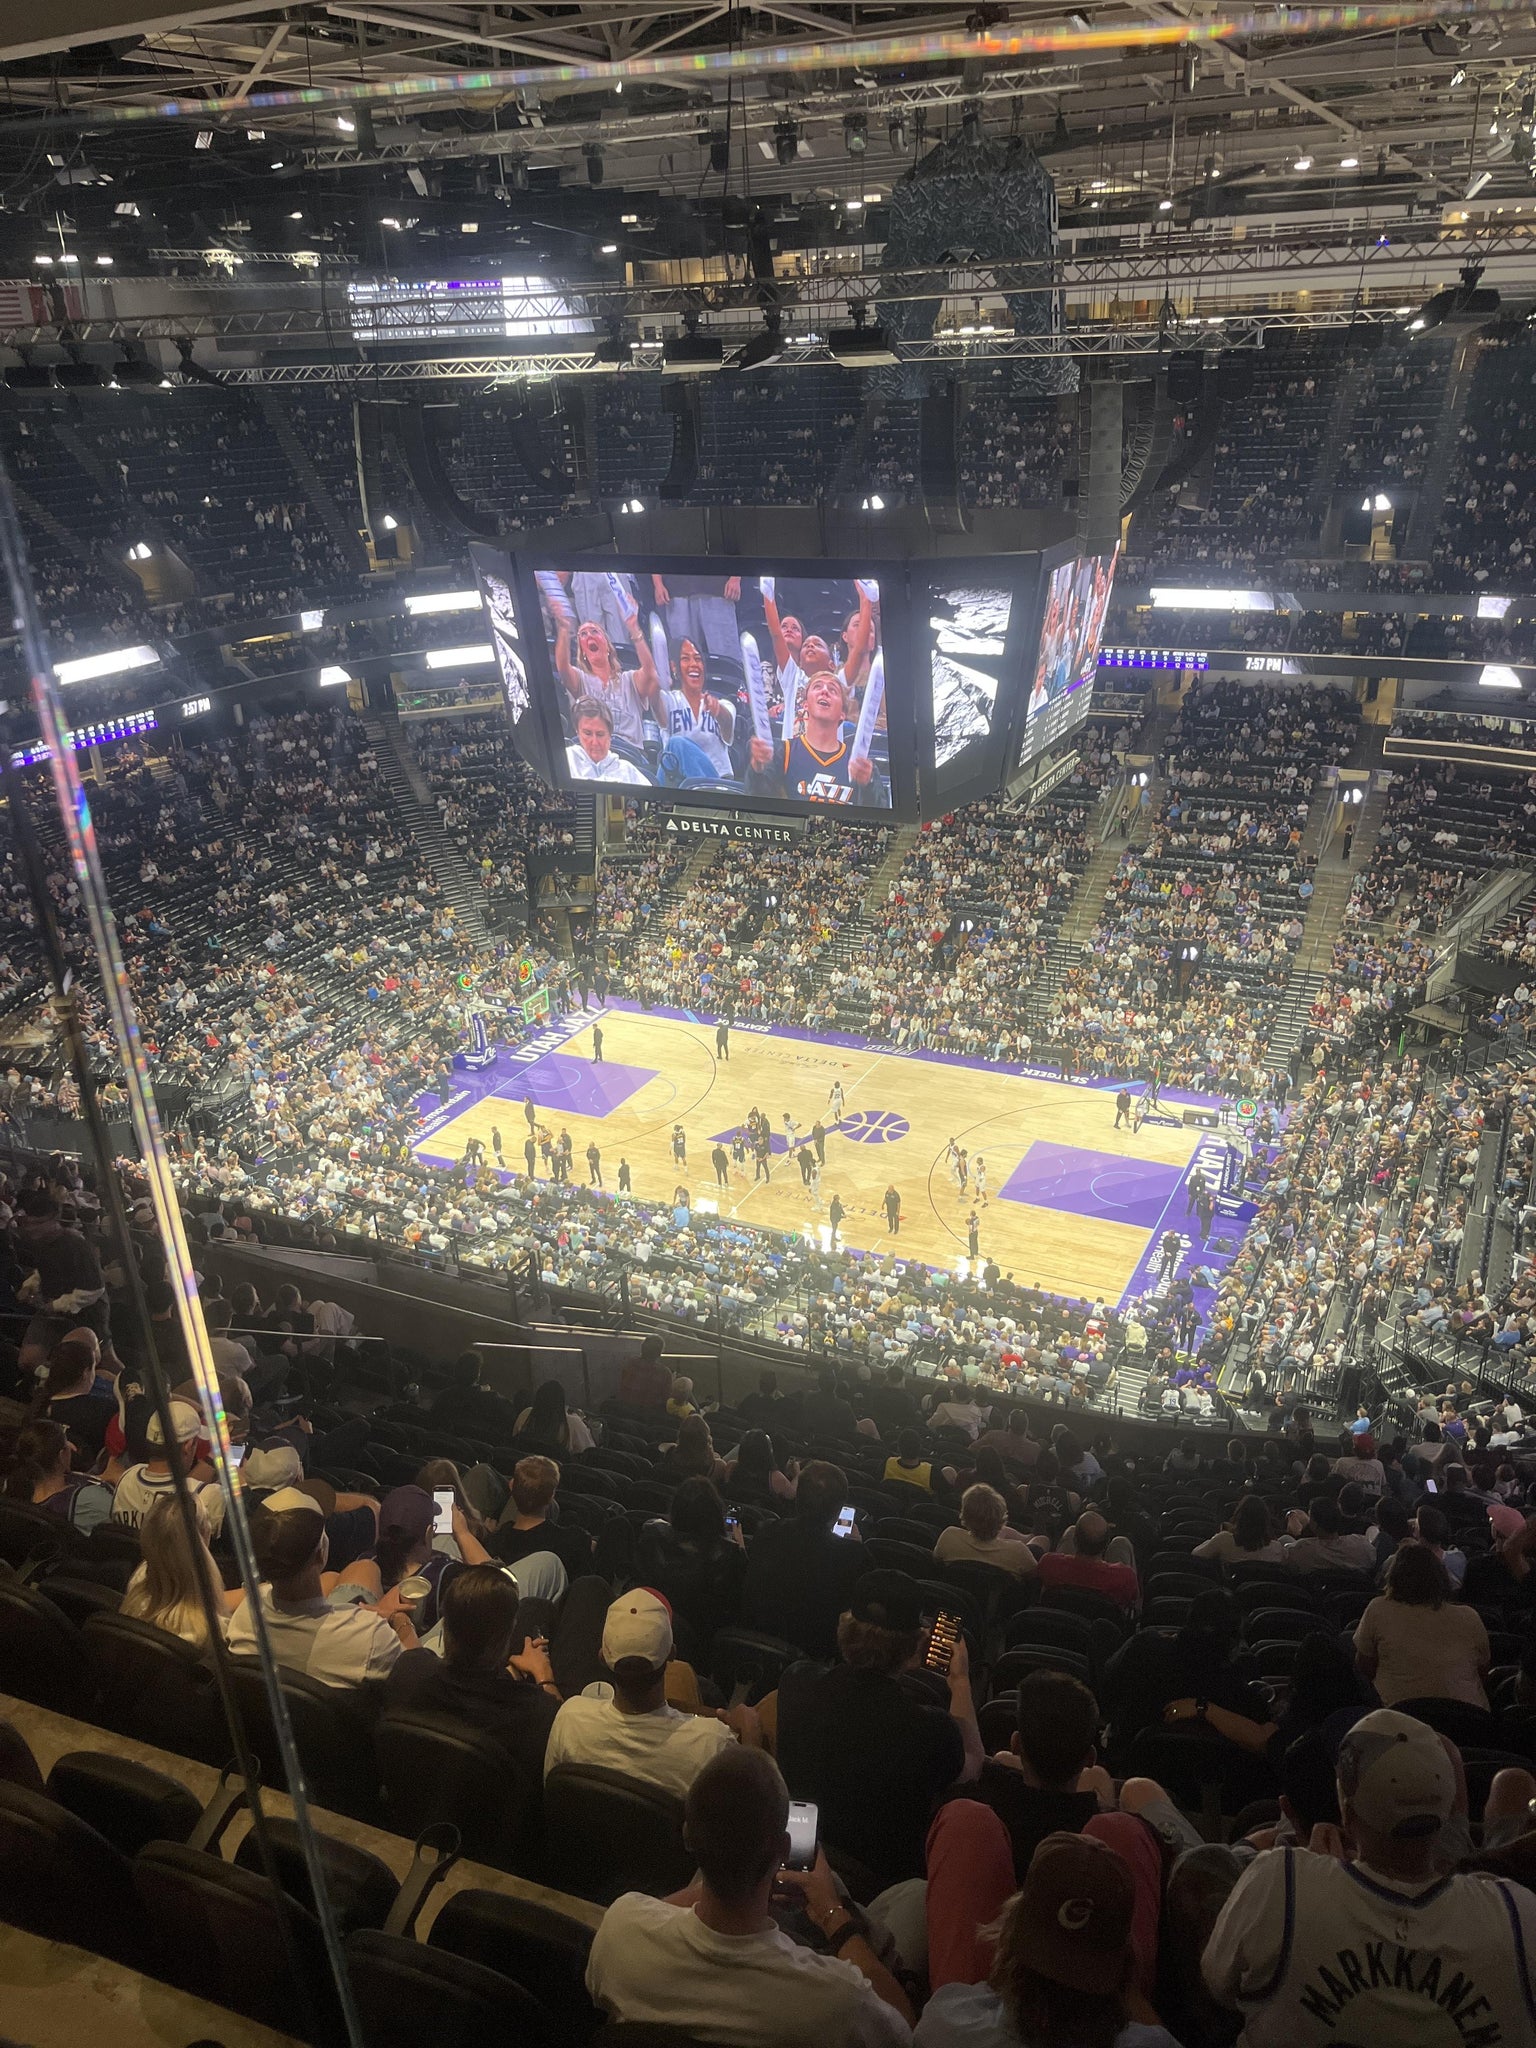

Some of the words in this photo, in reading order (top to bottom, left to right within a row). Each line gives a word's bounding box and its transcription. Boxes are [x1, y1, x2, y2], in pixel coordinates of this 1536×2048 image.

[1245, 657, 1264, 671] 7:57
[1266, 658, 1281, 671] PM
[680, 820, 730, 836] DELTA
[734, 826, 792, 842] CENTER
[510, 1031, 570, 1062] UTAH
[1300, 1942, 1502, 2048] MARKKANEN
